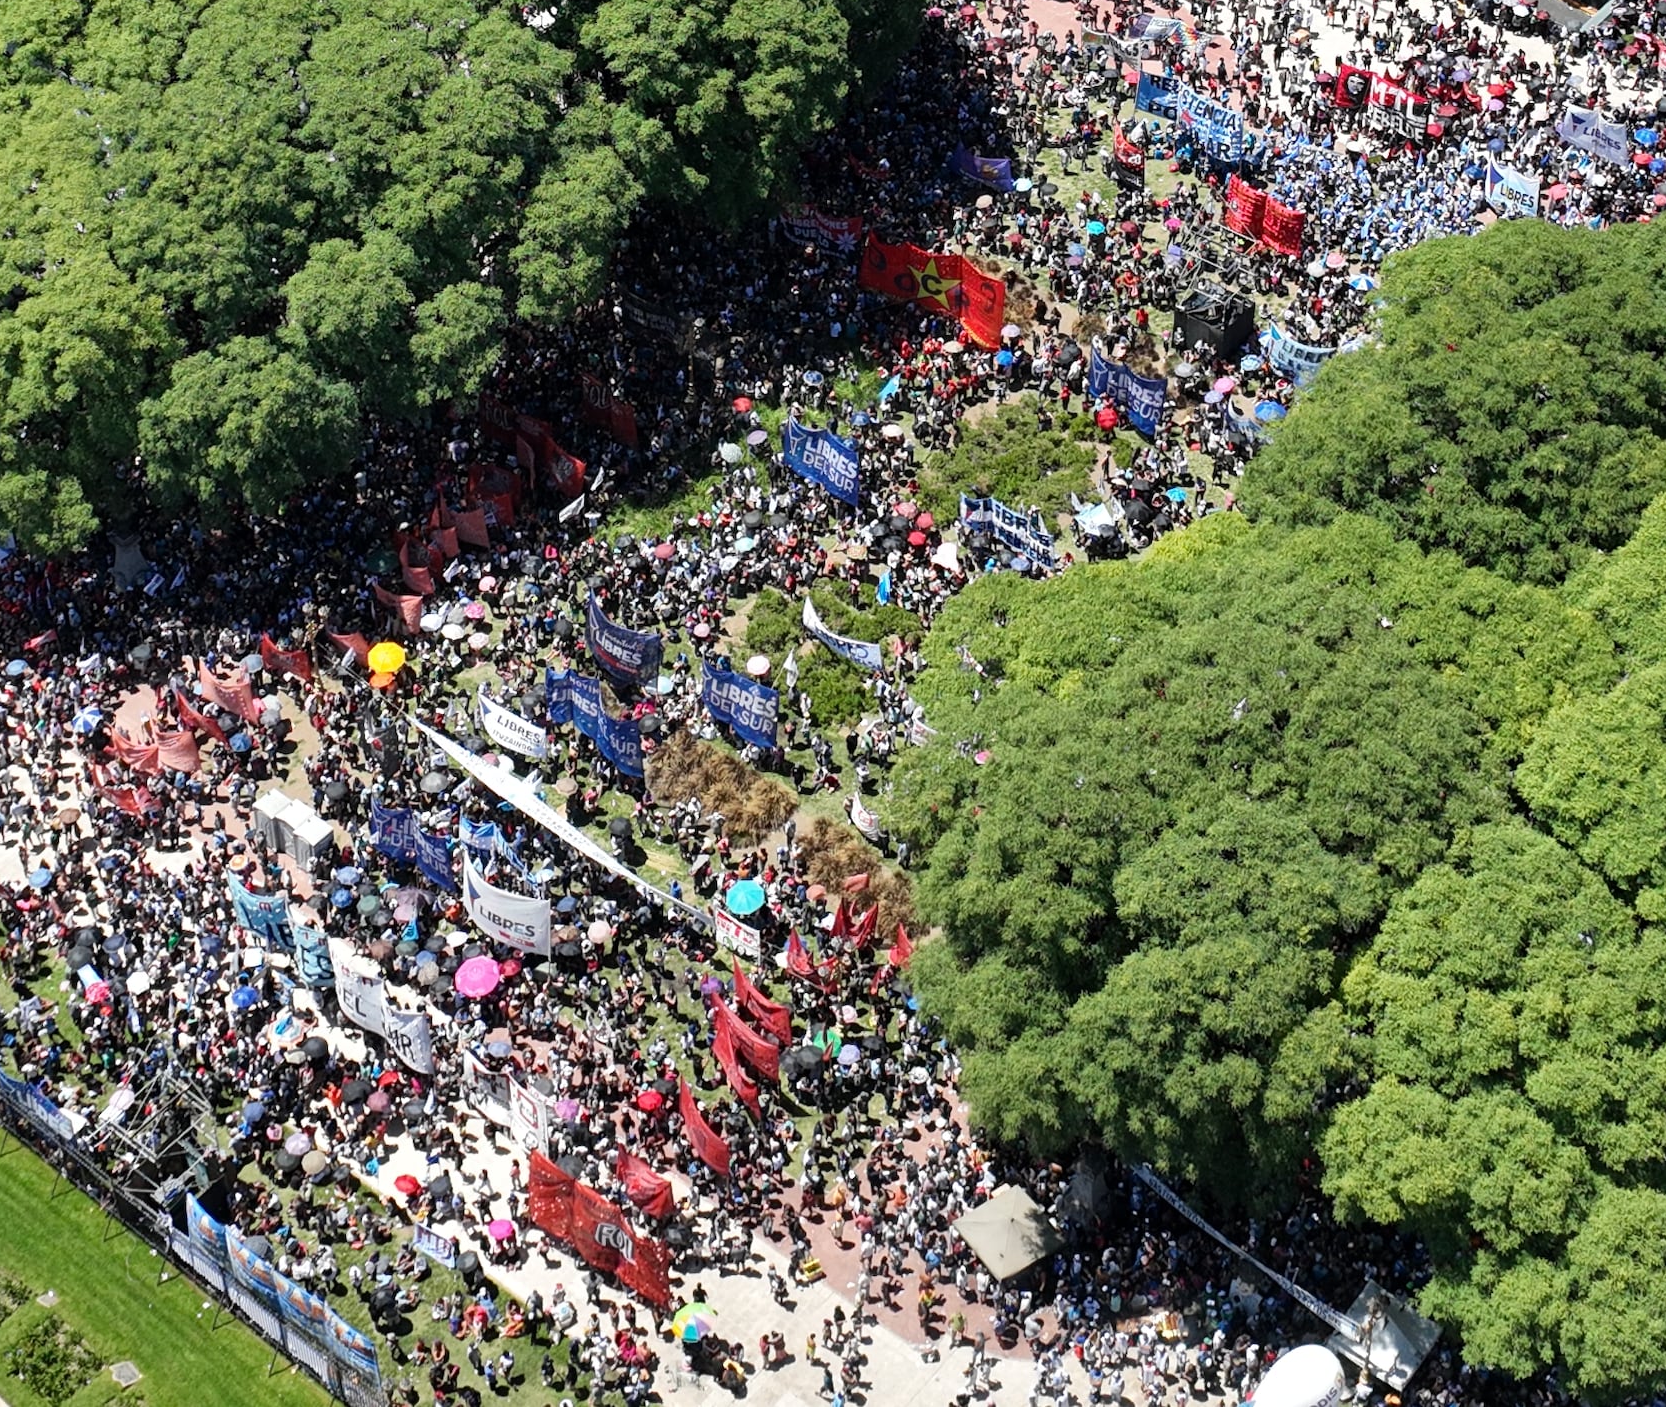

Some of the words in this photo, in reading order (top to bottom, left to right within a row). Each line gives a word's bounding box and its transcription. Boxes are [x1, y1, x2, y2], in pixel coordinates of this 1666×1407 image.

[1583, 126, 1621, 152] LIBRES
[1500, 182, 1535, 209] LIBRES
[1107, 370, 1164, 408] LIBRES
[805, 436, 858, 479] LIBRES
[827, 468, 855, 494] SUR
[595, 634, 642, 665] LIBRES
[711, 679, 776, 718] LIBRES
[496, 714, 542, 742] LIBRES
[737, 711, 774, 734] SUR
[479, 905, 535, 936] LIBRES
